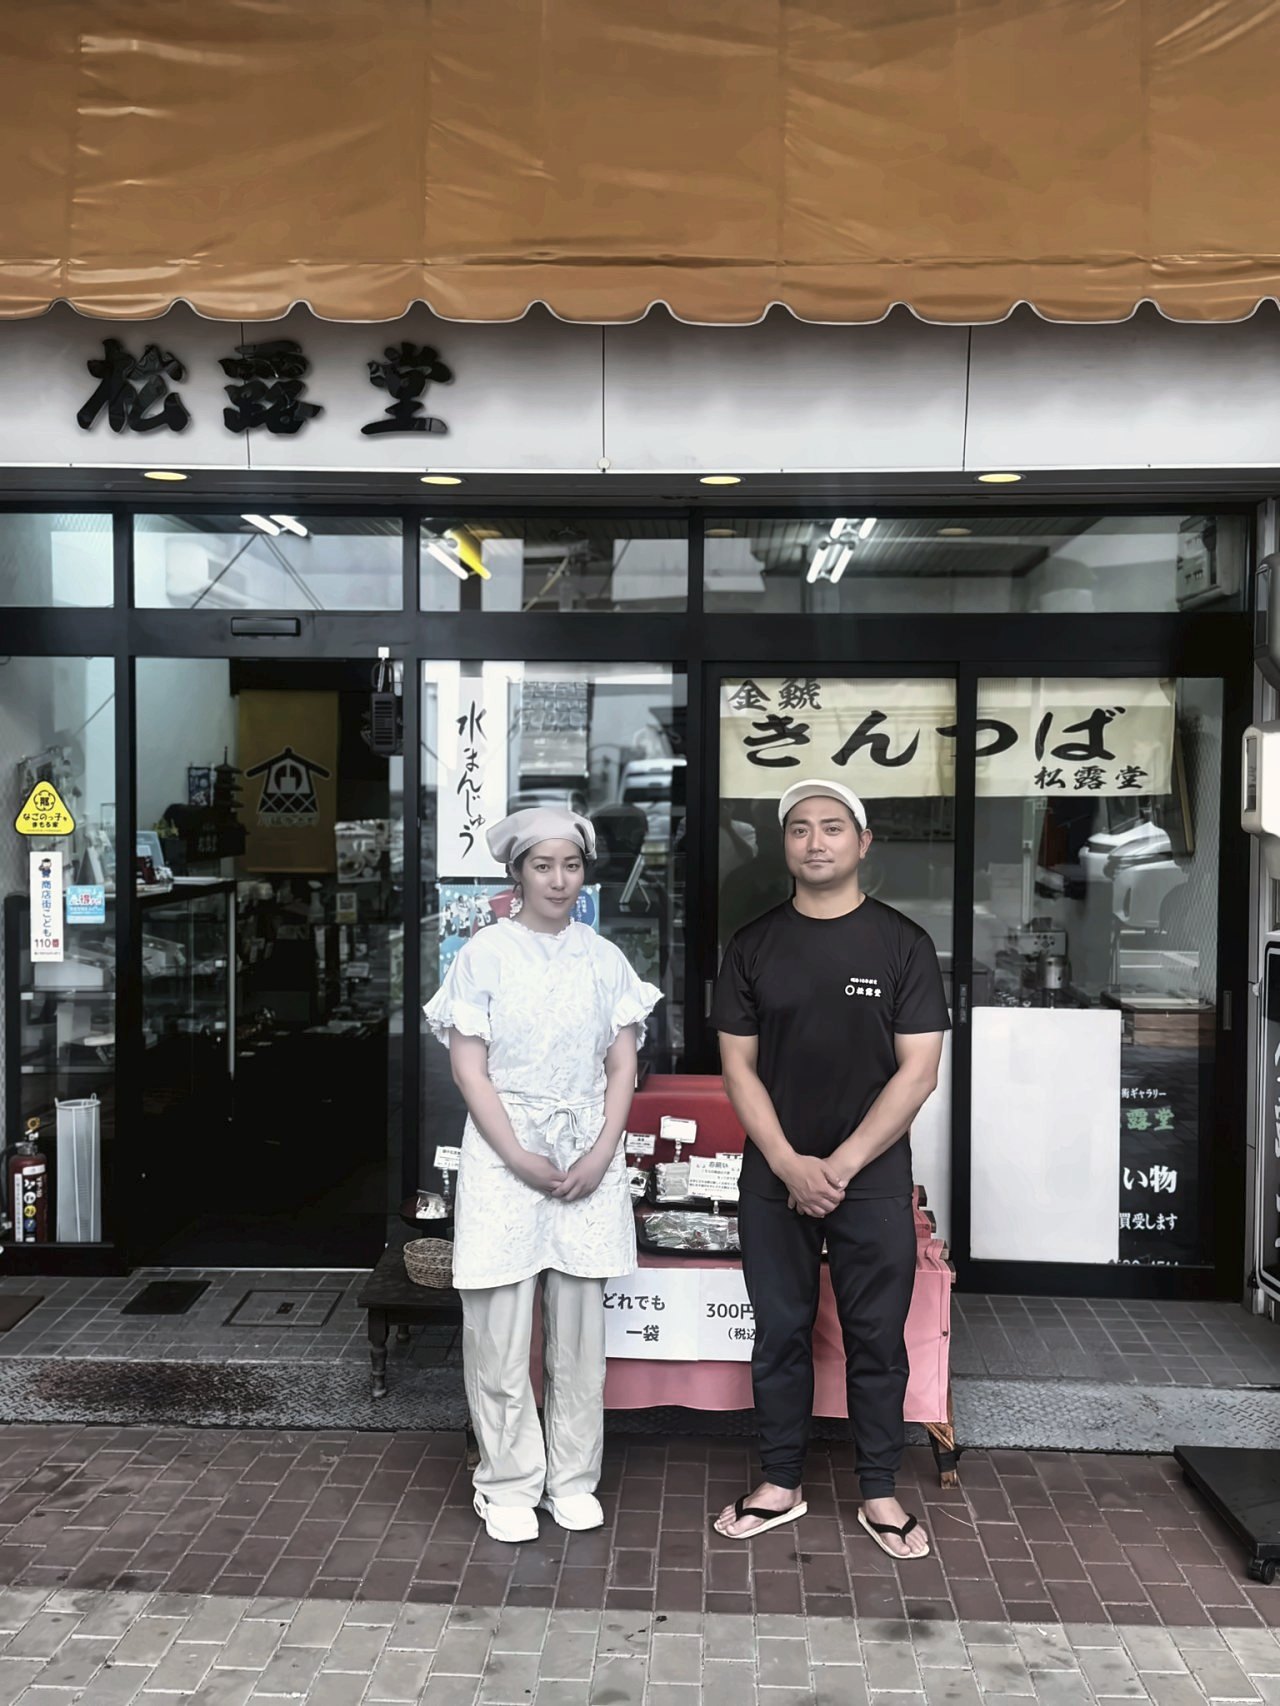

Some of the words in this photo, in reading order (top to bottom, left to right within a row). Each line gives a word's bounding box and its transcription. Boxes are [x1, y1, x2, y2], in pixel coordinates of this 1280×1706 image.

[77, 338, 453, 436] 松露堂
[728, 678, 822, 711] 金鯱
[743, 706, 1126, 768] きんつば
[456, 700, 487, 859] 水まんじゅう
[1034, 765, 1148, 790] 松露堂
[41, 881, 52, 938] 商店街こども
[1120, 1108, 1175, 1131] 露堂
[1123, 1165, 1178, 1193] い物
[1119, 1212, 1178, 1231] 買受します
[602, 1293, 666, 1311] どれでも
[706, 1303, 755, 1320] 300円
[626, 1324, 660, 1342] 一袋
